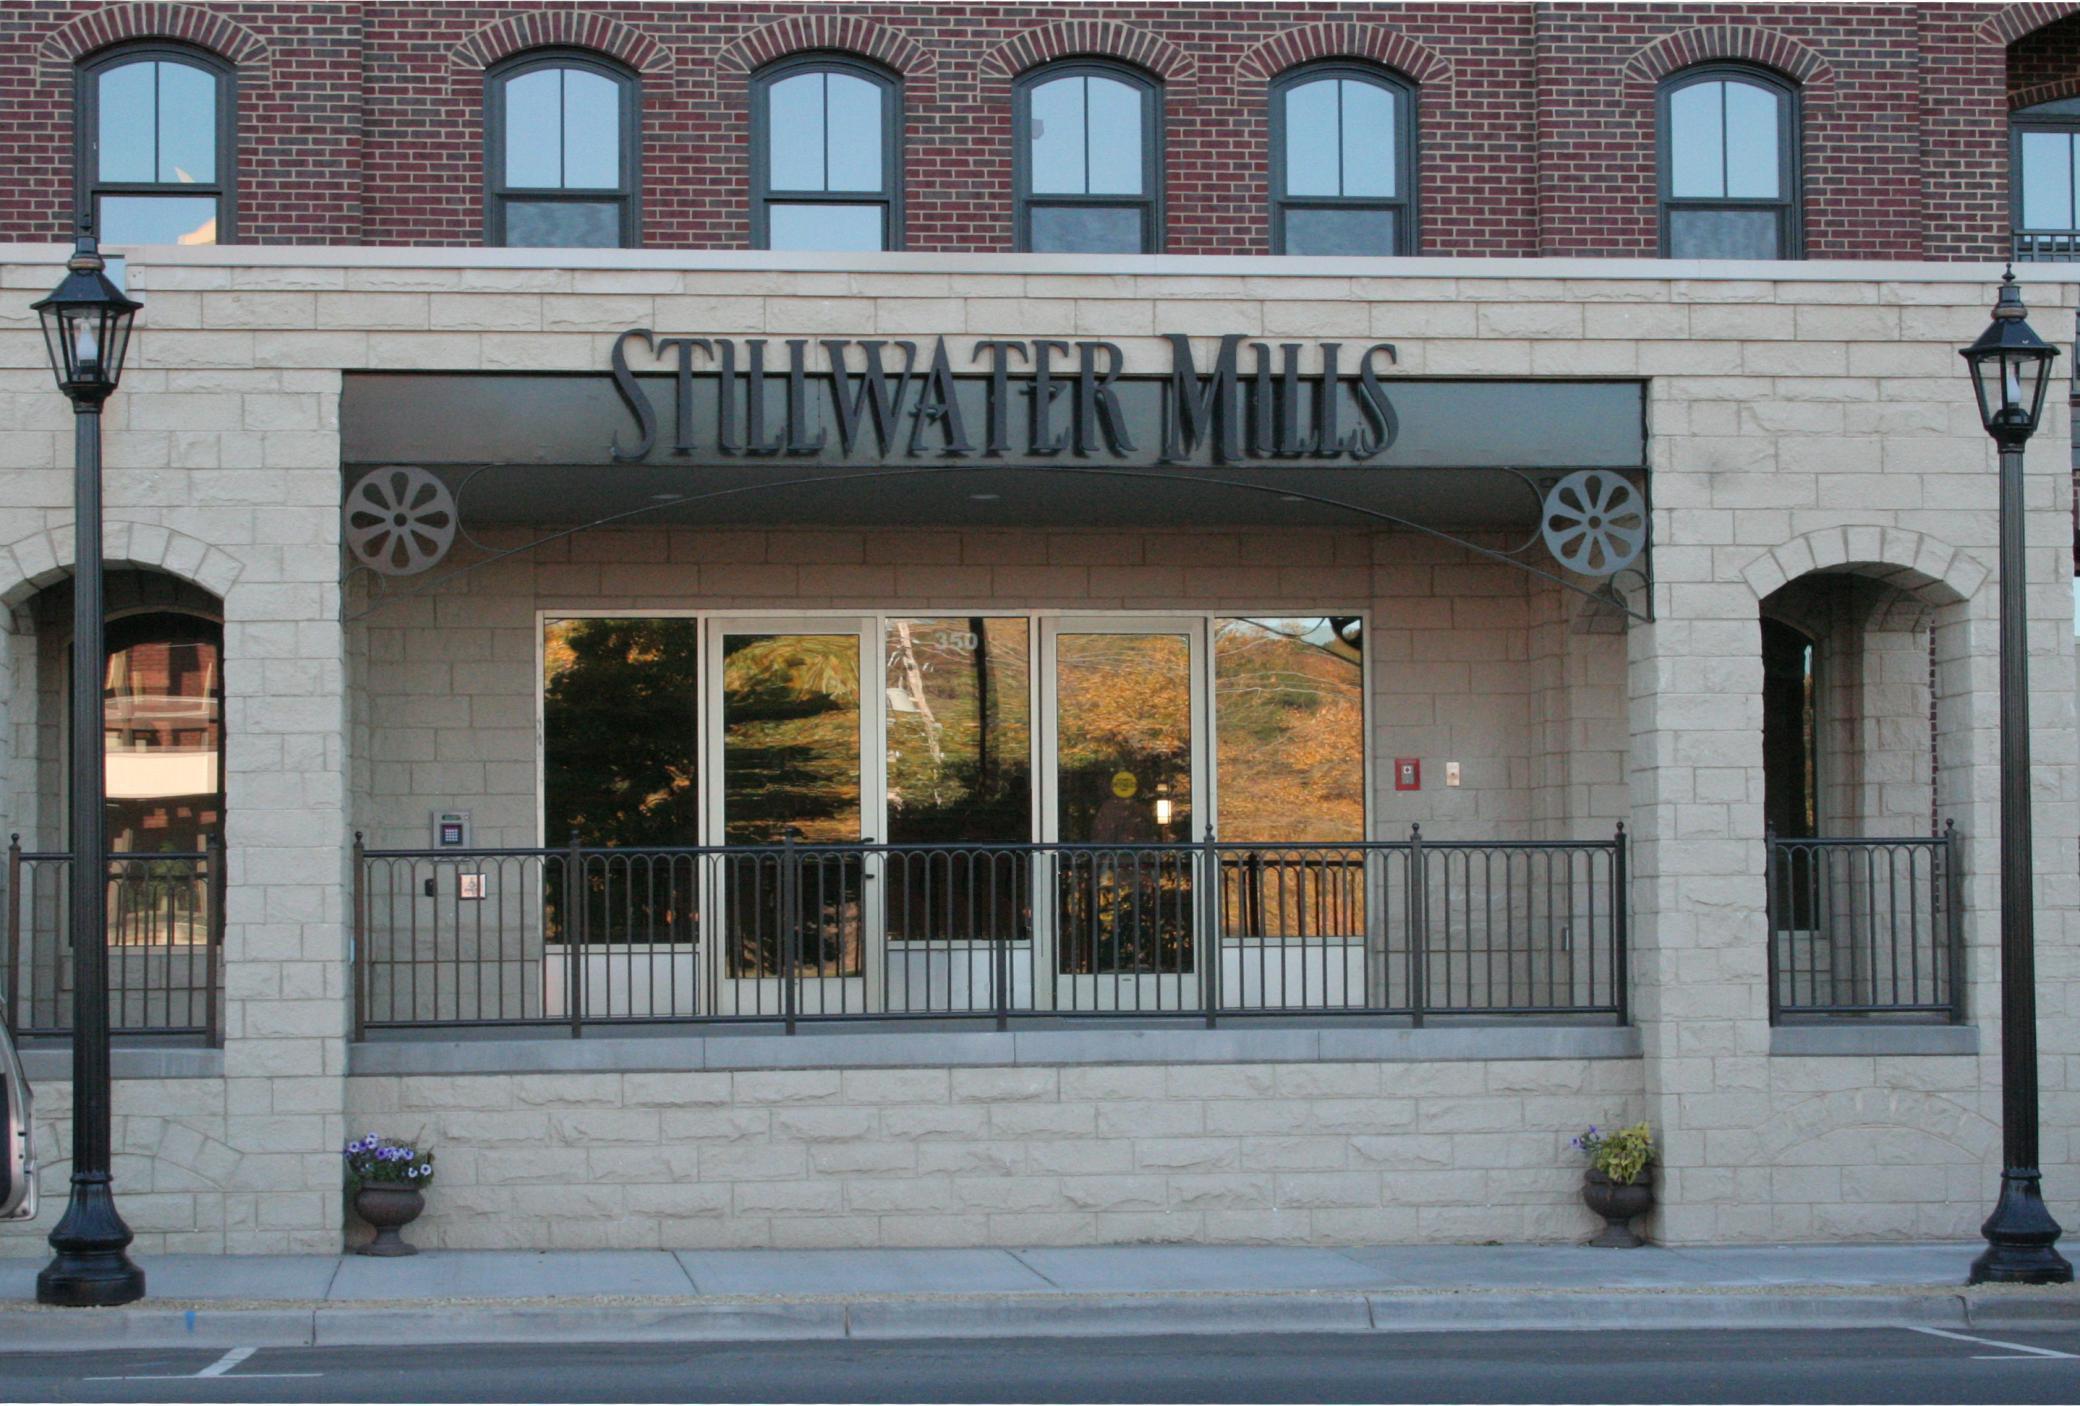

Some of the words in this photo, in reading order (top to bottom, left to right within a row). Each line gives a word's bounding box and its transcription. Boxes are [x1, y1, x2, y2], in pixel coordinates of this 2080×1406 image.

[612, 328, 1138, 462] STILLWATER
[1161, 333, 1400, 462] MILLS
[934, 630, 979, 651] 350
